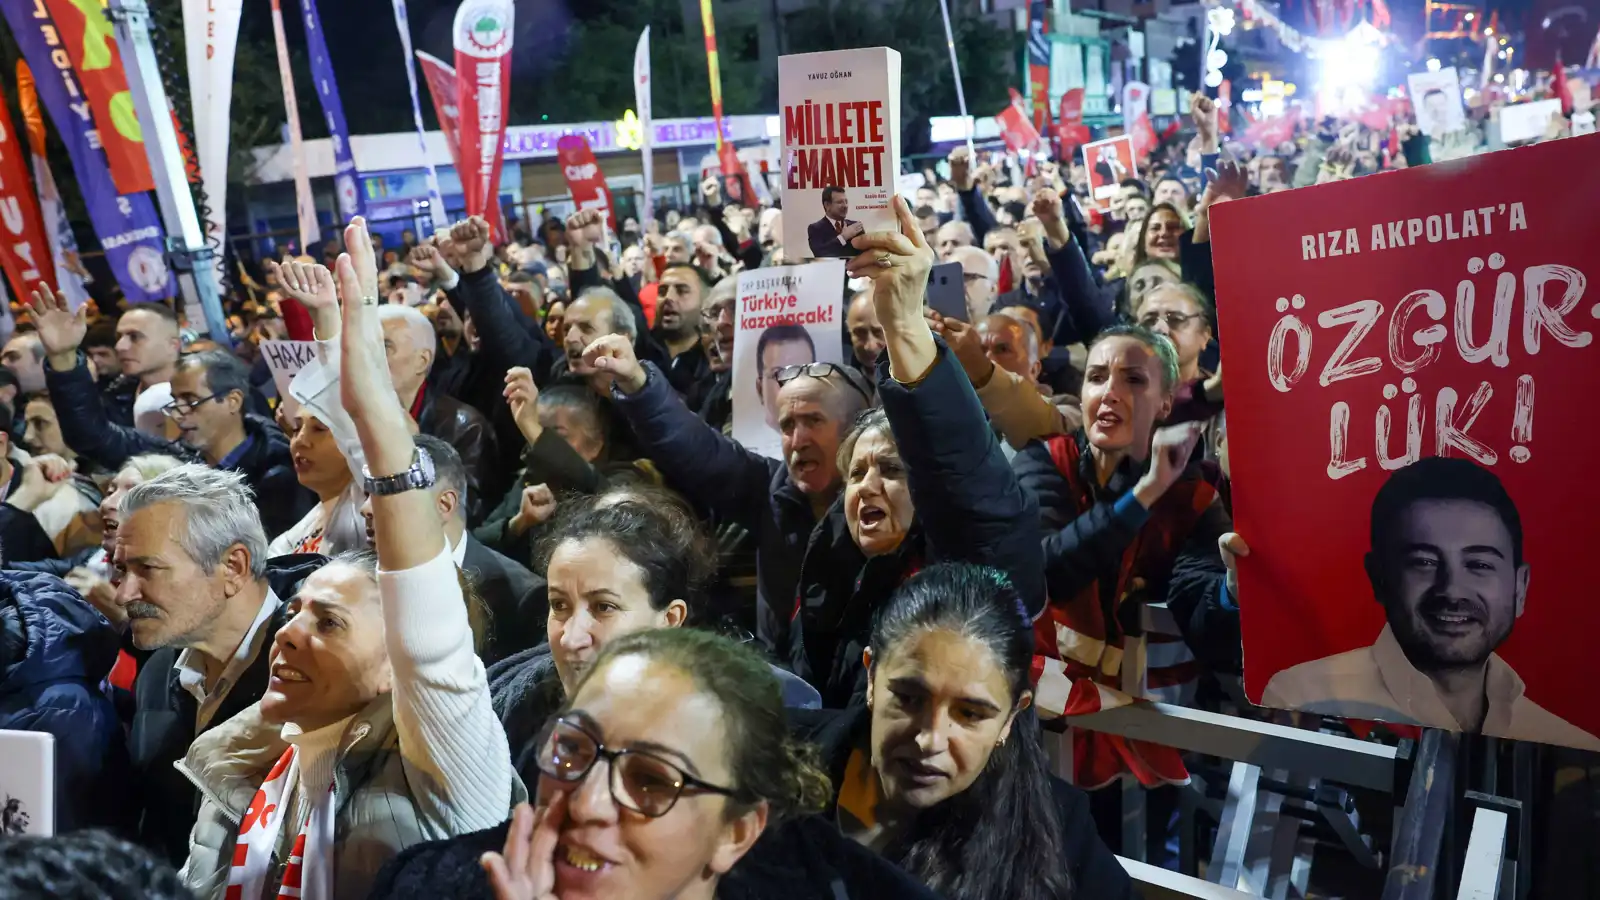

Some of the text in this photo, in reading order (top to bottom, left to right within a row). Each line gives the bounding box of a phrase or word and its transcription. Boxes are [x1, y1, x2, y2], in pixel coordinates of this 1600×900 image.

[830, 70, 852, 79] OĞHAN
[784, 99, 884, 146] MİLLETE
[787, 146, 885, 189] EMANET
[1302, 228, 1361, 261] RIZA
[740, 304, 834, 330] kazanacak!
[741, 292, 798, 313] Türkiye
[1326, 374, 1536, 480] LÜK!
